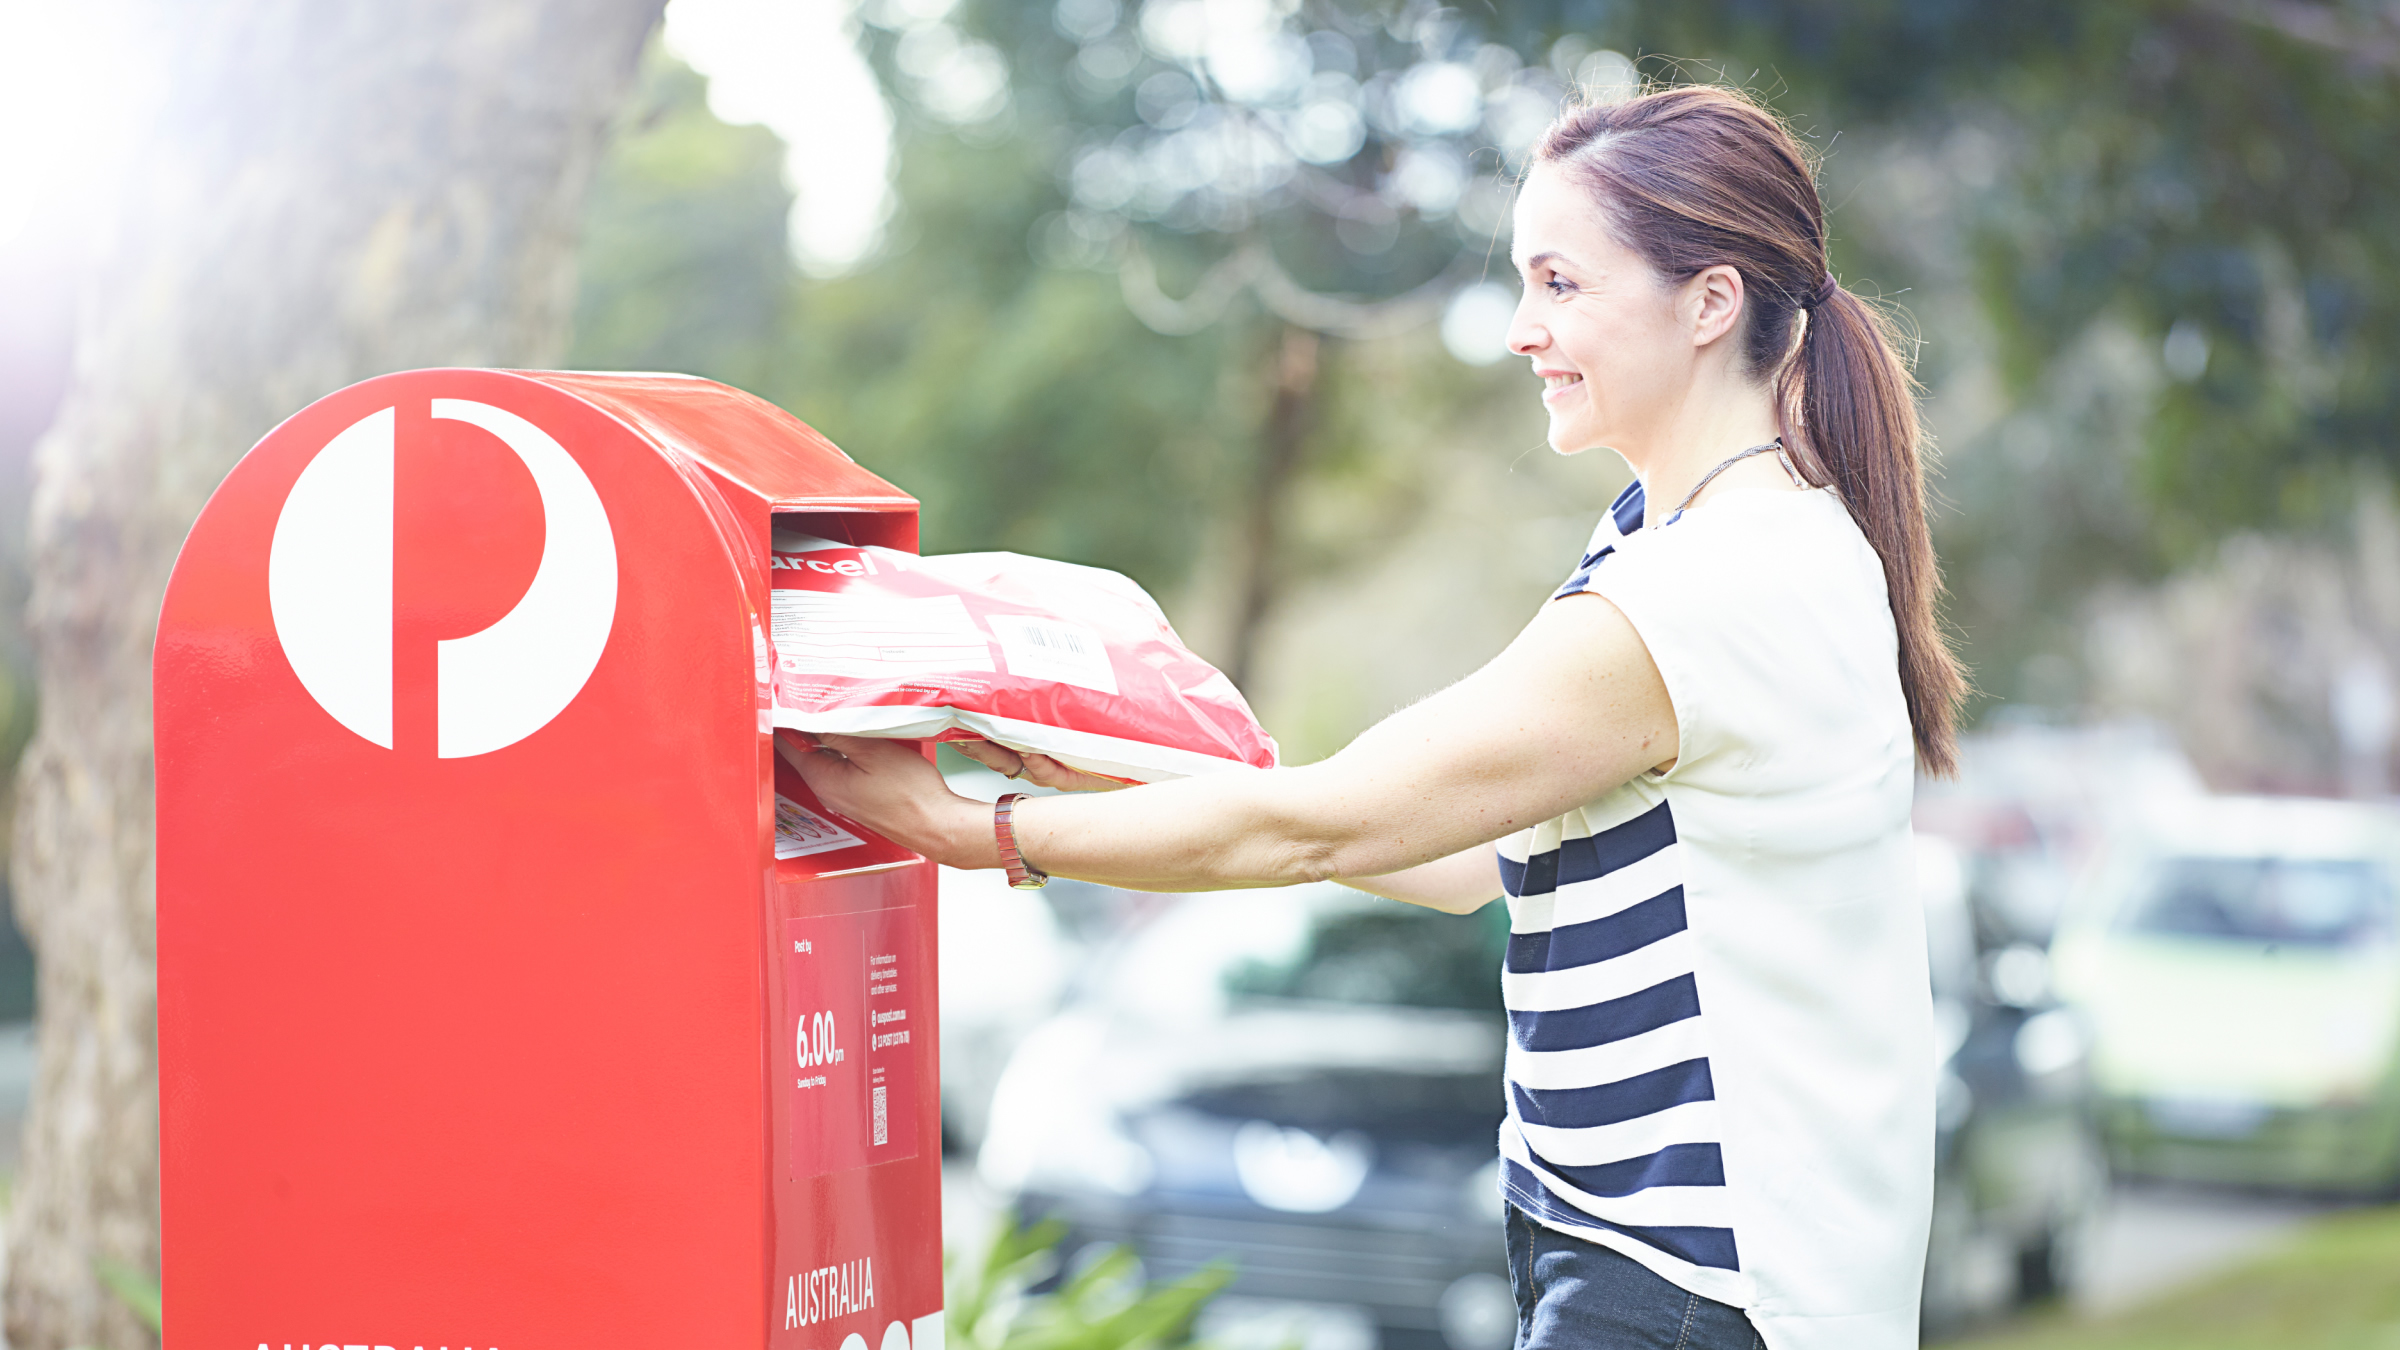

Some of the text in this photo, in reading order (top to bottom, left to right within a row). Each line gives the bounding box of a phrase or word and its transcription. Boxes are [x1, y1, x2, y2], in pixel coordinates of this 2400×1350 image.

[771, 552, 879, 577] arcel
[794, 938, 812, 955] Post by
[877, 1009, 906, 1025] auspost.com.au
[883, 1033, 892, 1047] POST
[797, 1075, 826, 1089] Sunday to Friday
[785, 1256, 874, 1330] AUSTRALIA
